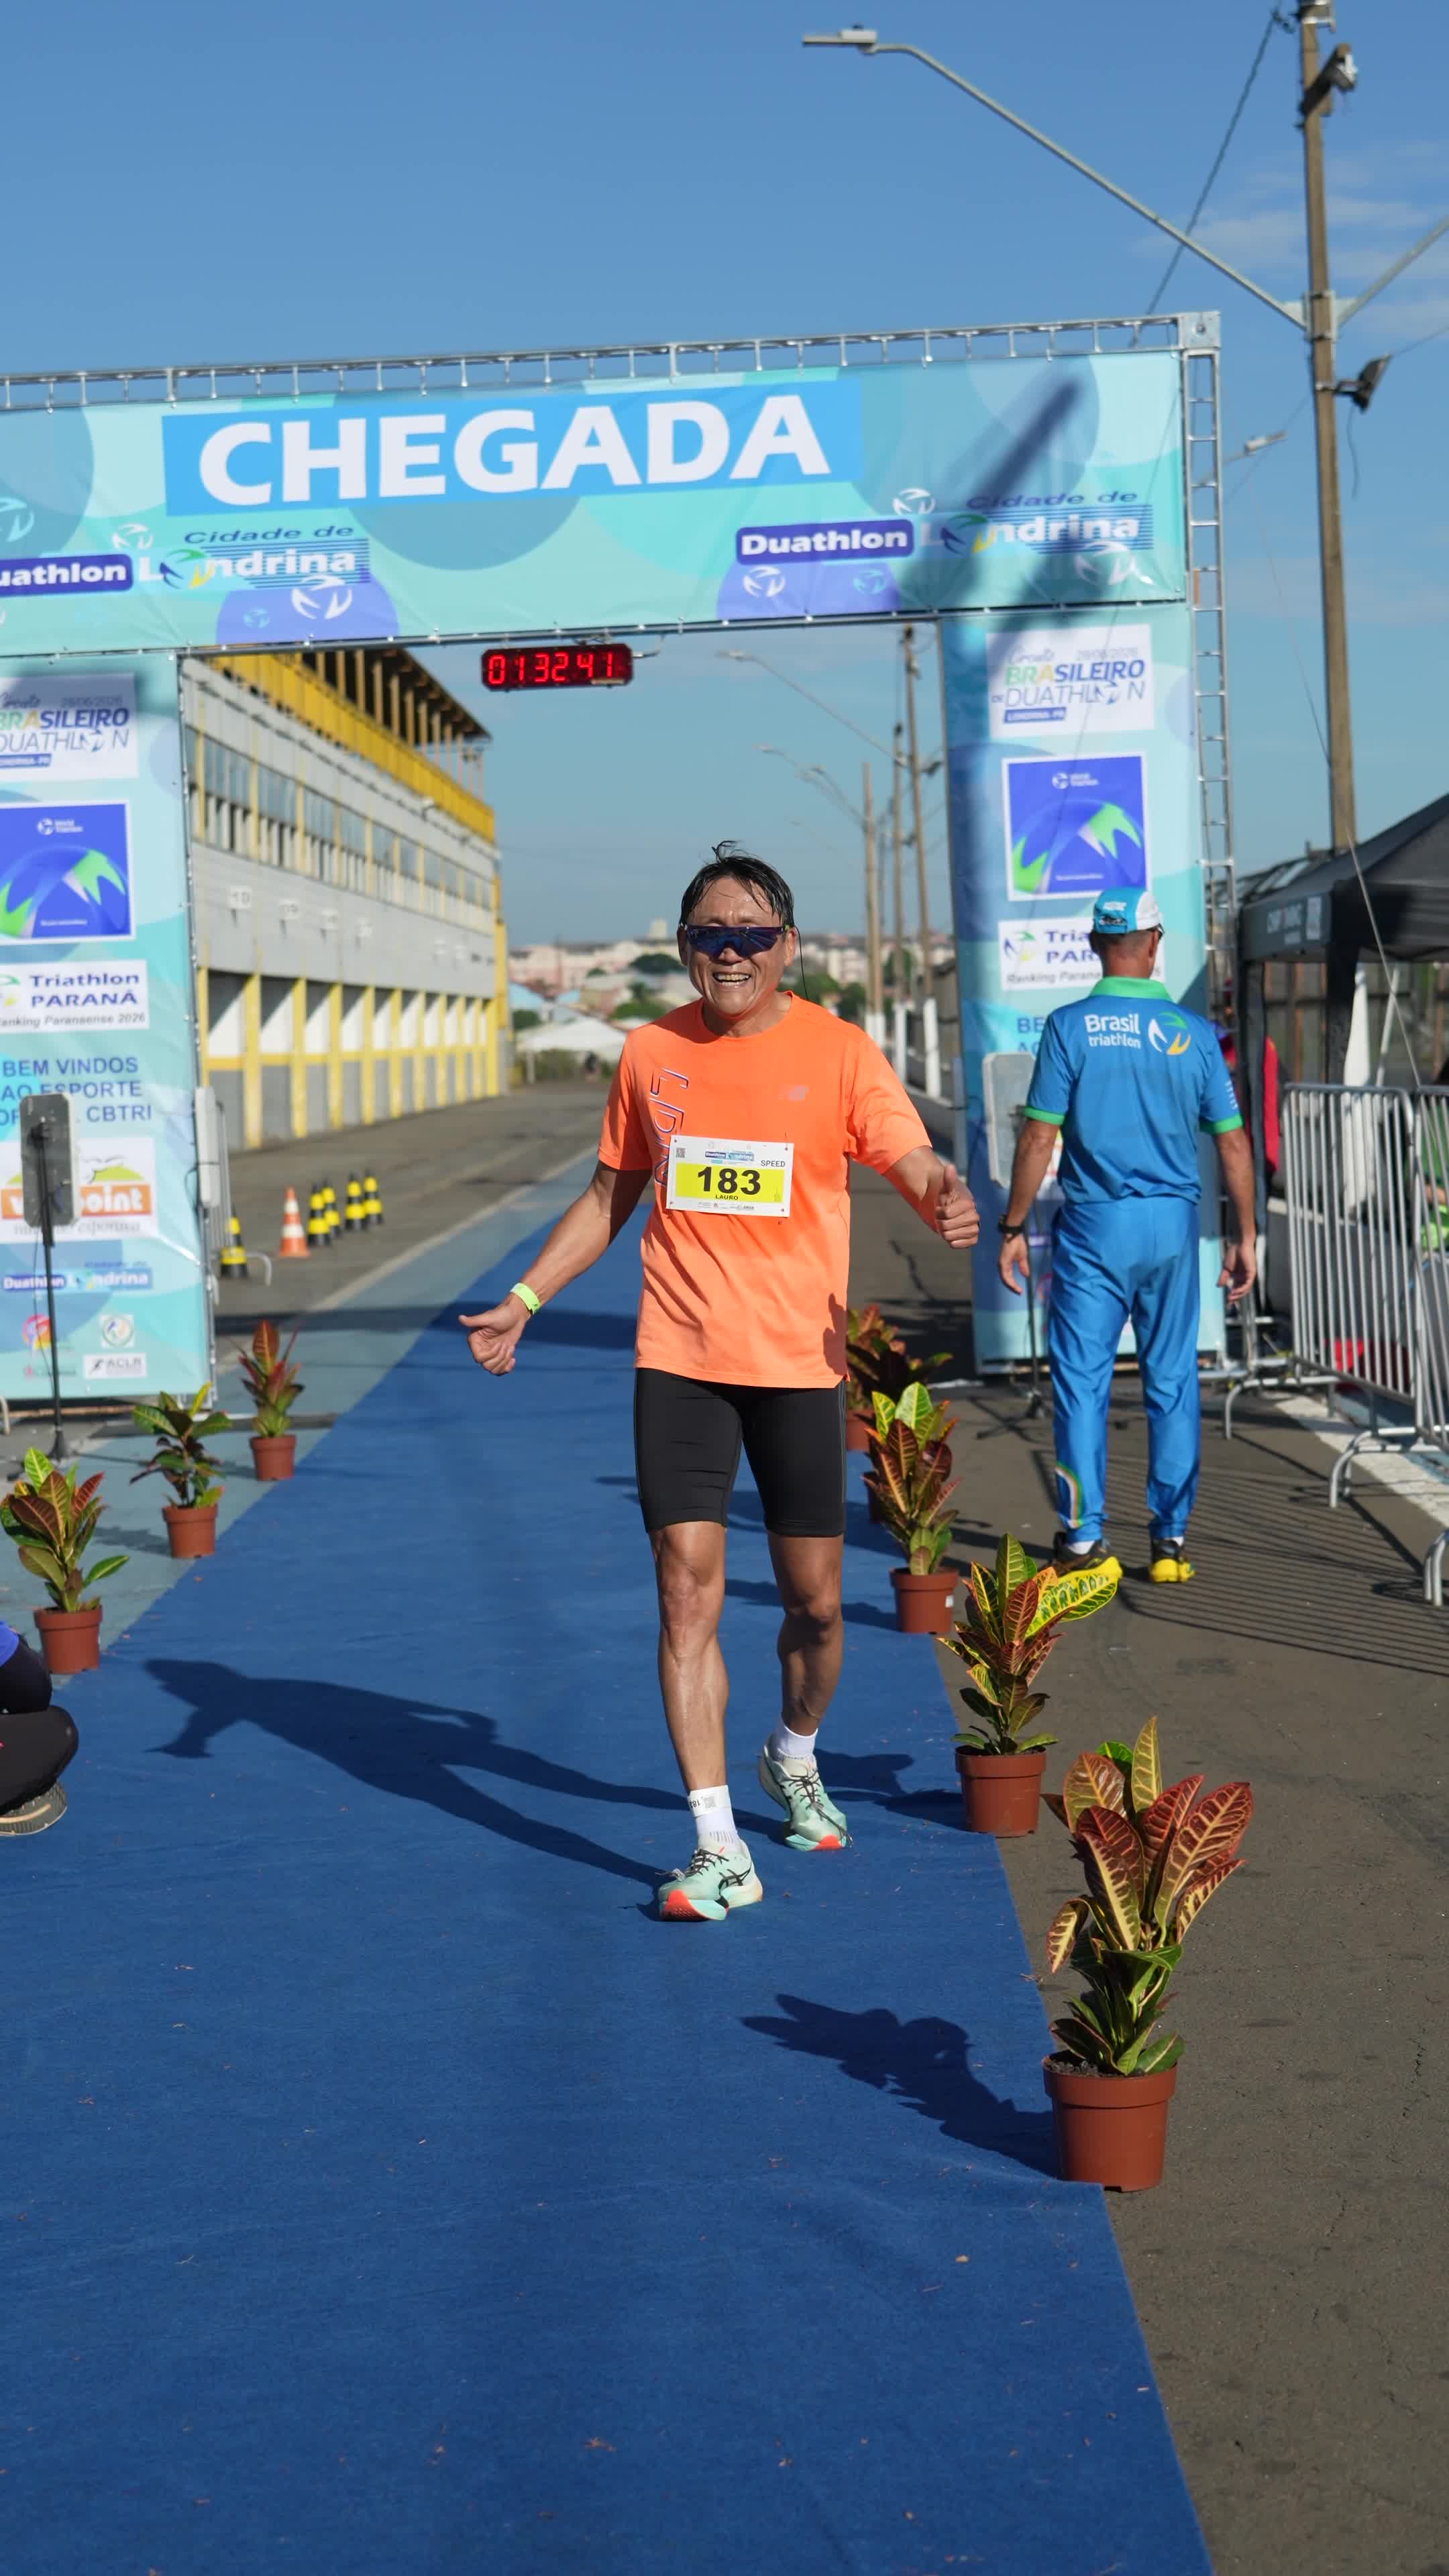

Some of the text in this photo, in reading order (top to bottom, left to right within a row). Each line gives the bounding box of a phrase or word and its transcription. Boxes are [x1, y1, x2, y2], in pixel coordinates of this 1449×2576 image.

[199, 395, 830, 505] CHEGADA
[967, 491, 1138, 509] Cidade de
[184, 526, 354, 544] Cidade de
[741, 529, 907, 555] Duathlon
[0, 562, 127, 587] uathlon
[1008, 659, 1146, 686] BRASILEIRO
[1046, 949, 1101, 963] PAR
[29, 973, 140, 987] Triathlon
[32, 989, 138, 1008] PARANÁ
[0, 1014, 41, 1028] anking
[1017, 1016, 1046, 1034] BE
[1084, 1013, 1140, 1034] Brasil
[1088, 1034, 1140, 1049] triathlon
[3, 1057, 139, 1077] BEM VINDOS
[1, 1080, 143, 1101] AO ESPORTE
[86, 1105, 152, 1123] CBTRI
[760, 1159, 786, 1168] SPEED
[698, 1166, 761, 1195] 183
